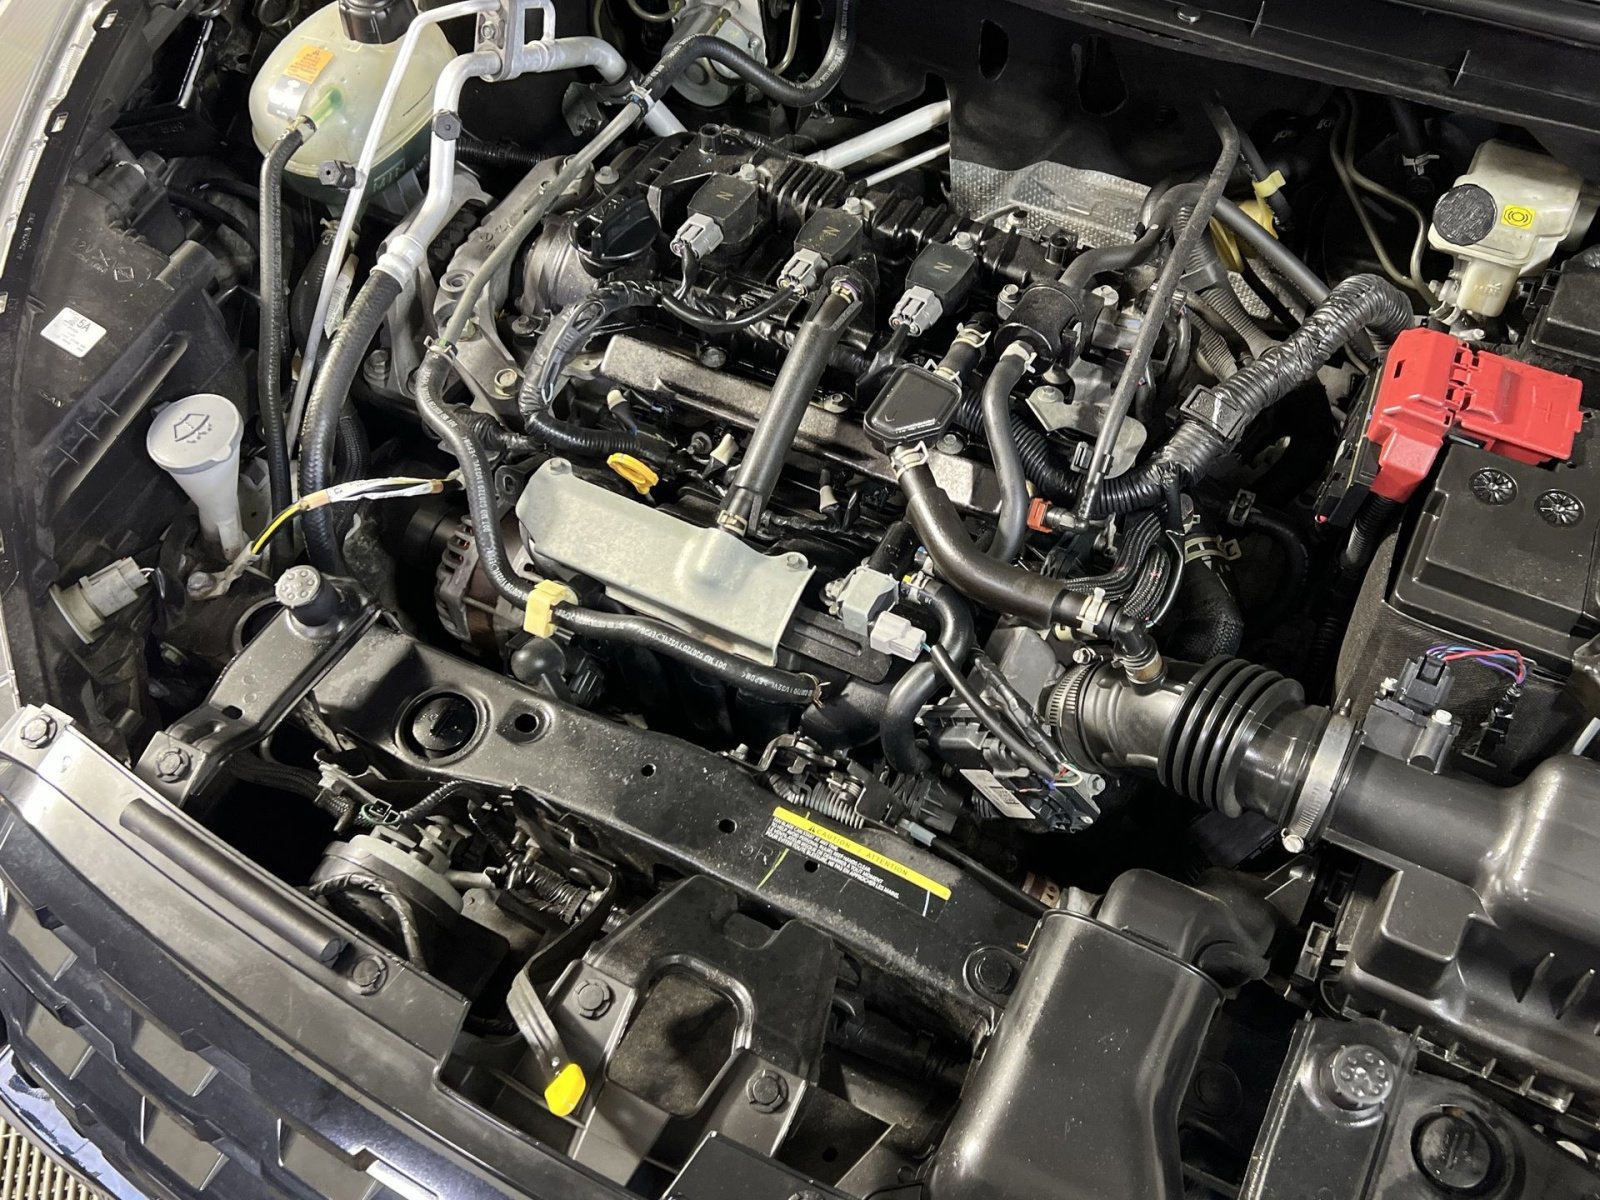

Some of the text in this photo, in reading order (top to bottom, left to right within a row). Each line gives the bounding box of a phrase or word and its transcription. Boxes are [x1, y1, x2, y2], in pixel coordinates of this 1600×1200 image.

[765, 829, 778, 840] POUR
[834, 863, 843, 871] PAS
[849, 870, 876, 887] APPROCHER
[875, 883, 884, 891] LES
[773, 828, 801, 844] VENTILATEUR
[850, 865, 862, 874] TOUT
[786, 828, 799, 838] AVOID
[798, 834, 819, 847] PERSONAL
[816, 828, 851, 848] CAUTION
[865, 852, 908, 876] ATTENTION
